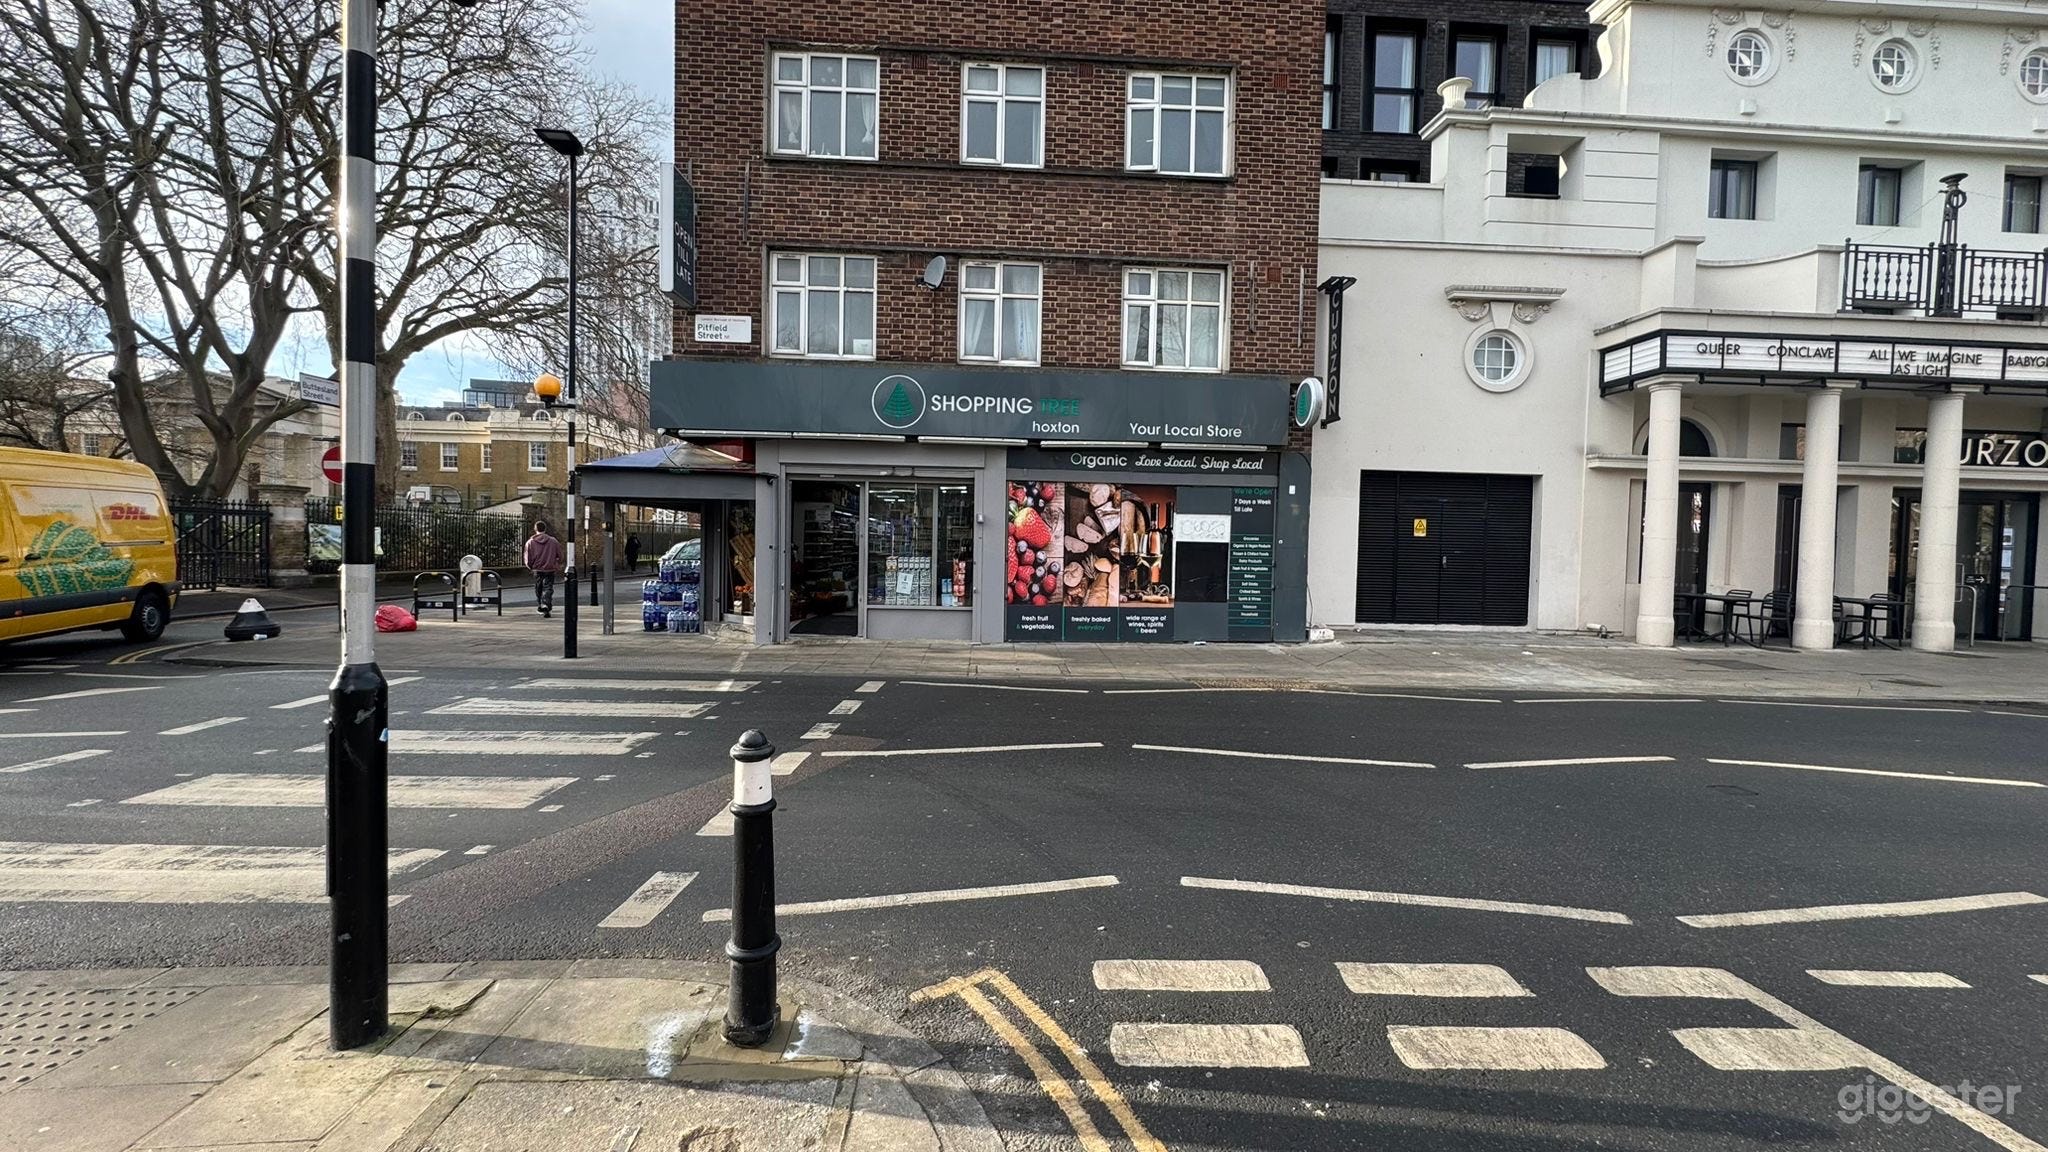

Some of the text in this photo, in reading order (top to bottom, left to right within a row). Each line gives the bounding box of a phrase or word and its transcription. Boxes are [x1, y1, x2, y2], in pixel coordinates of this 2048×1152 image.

[674, 221, 693, 249] OPEN
[677, 243, 690, 265] TILL
[676, 261, 692, 285] LATE
[697, 323, 728, 332] Pitfield
[697, 332, 723, 340] Street
[1328, 289, 1340, 416] CURZON
[1696, 342, 1741, 355] QUEER
[1767, 345, 1834, 359] CONCLAVE
[1869, 349, 1983, 365] ALL WE IMAGINE
[1894, 363, 1949, 376] AS LIGHT
[302, 389, 325, 400] Street
[930, 394, 1081, 417] SHOPPING TREE
[1032, 421, 1080, 433] hoxton
[1130, 423, 1242, 438] Your Local Store
[1960, 438, 2048, 467] URZO
[1071, 453, 1128, 468] Organic
[1135, 454, 1162, 467] Love
[1200, 456, 1231, 472] Shop
[1232, 458, 1264, 470] Local
[110, 505, 150, 520] DHL
